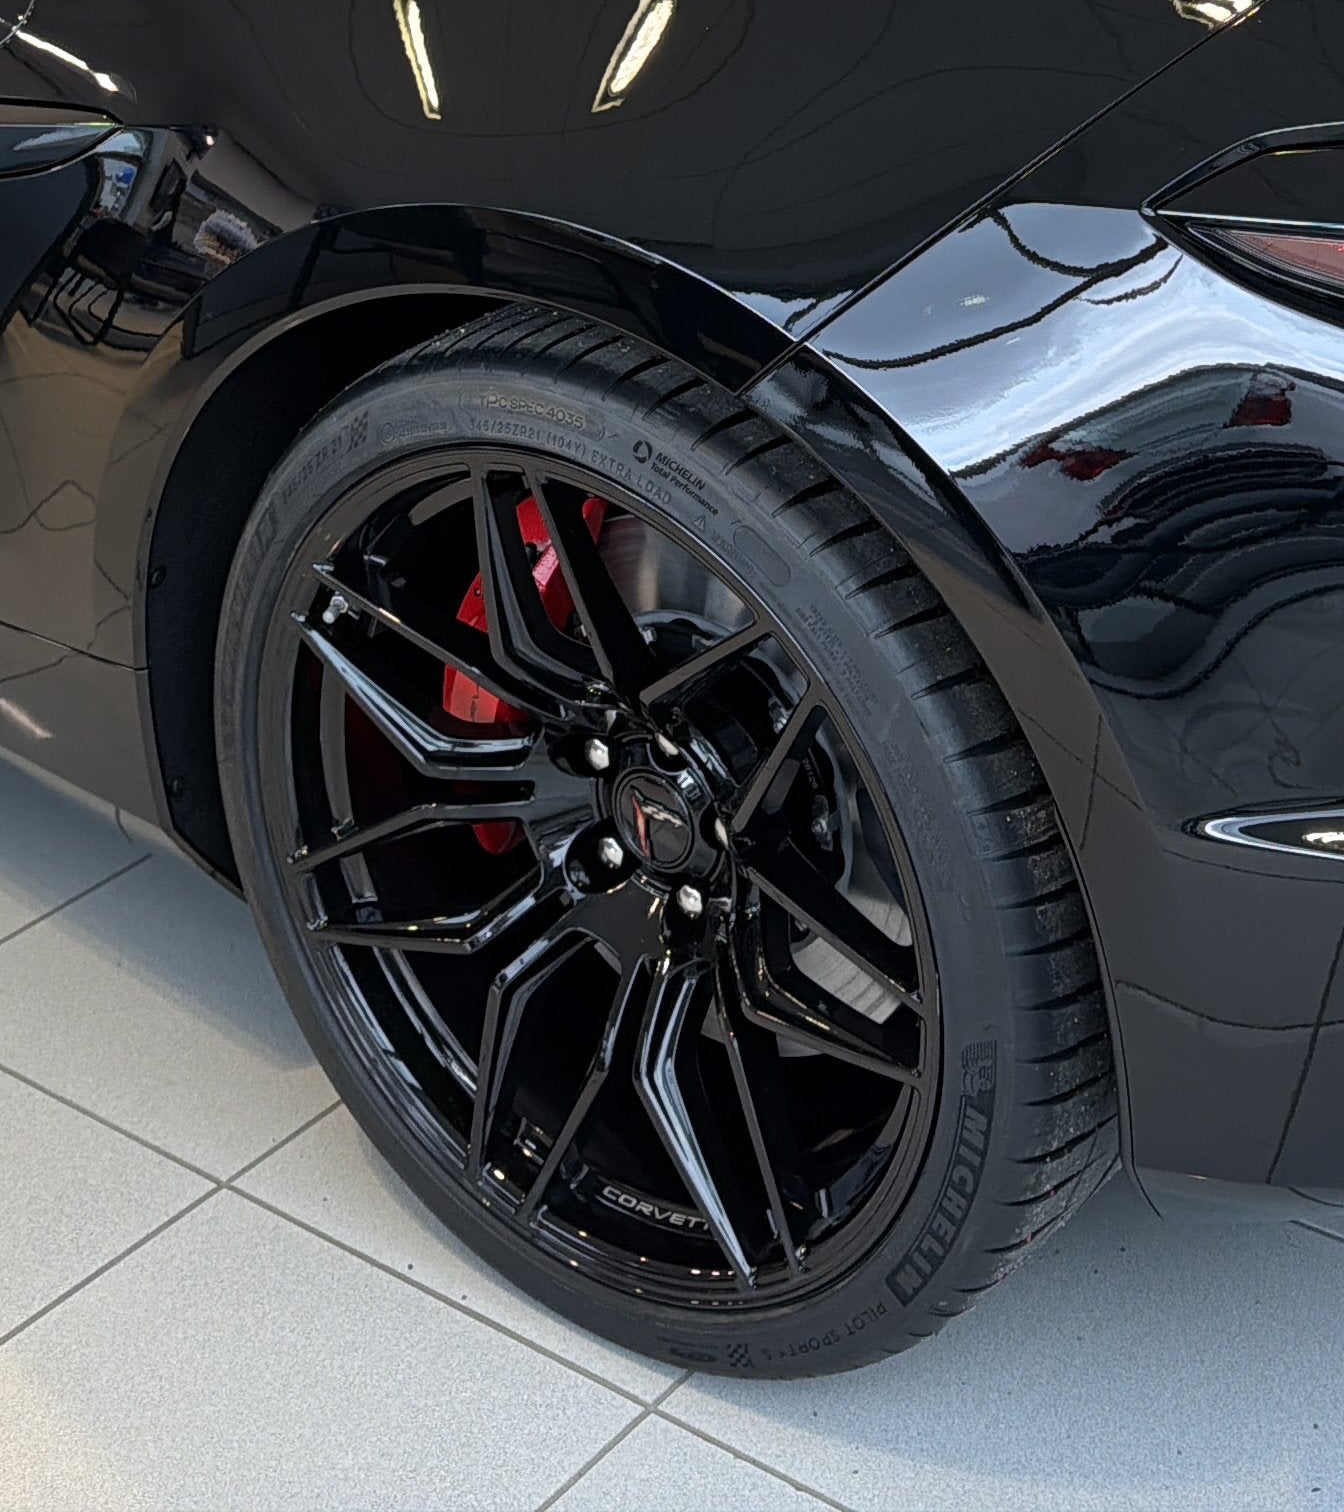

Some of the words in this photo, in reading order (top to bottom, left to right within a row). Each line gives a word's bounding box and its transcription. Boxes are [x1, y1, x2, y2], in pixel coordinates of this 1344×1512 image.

[510, 397, 544, 416] SPEC
[545, 406, 586, 430] 4035
[590, 449, 633, 482] EXTRA
[635, 473, 673, 505] LOAD
[649, 461, 671, 482] Total
[668, 474, 720, 516] Performance
[654, 452, 708, 492] MICHELIN
[601, 1185, 710, 1231] CORVETT
[895, 1105, 990, 1302] MICHELIN
[843, 1298, 889, 1337] PILOT
[787, 1328, 842, 1358] SPORT
